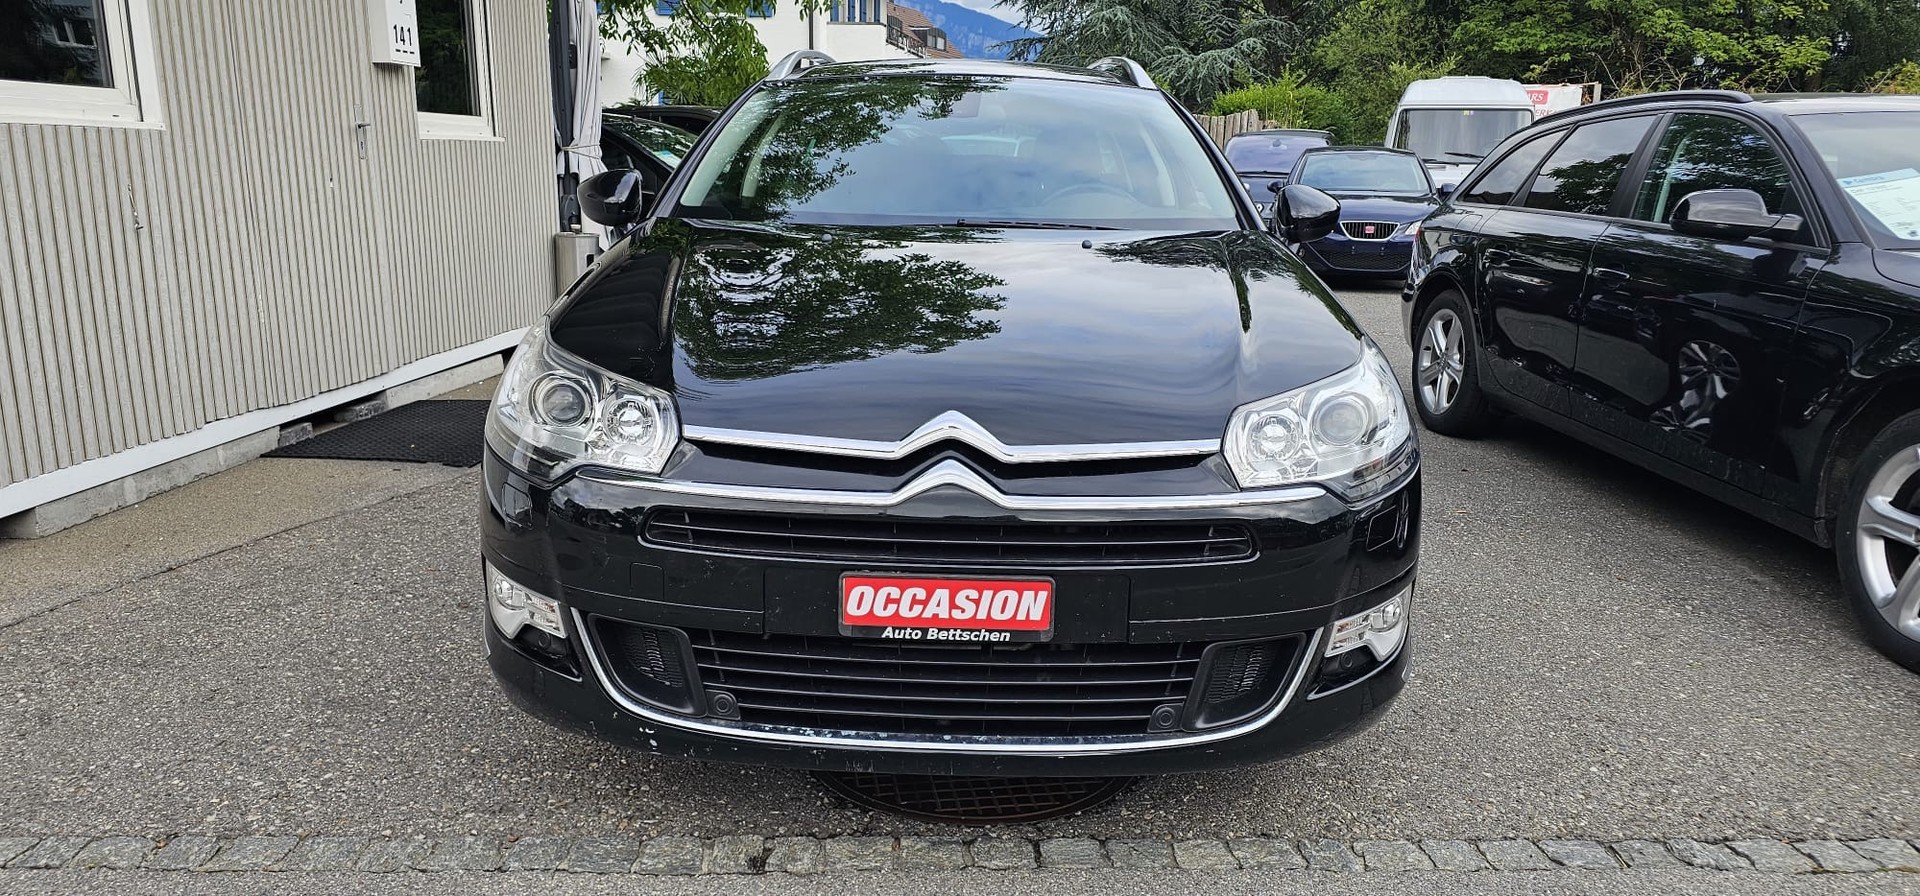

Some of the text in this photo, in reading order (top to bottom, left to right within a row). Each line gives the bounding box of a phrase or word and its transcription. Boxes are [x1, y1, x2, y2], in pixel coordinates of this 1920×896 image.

[393, 24, 412, 46] 141
[846, 585, 1048, 621] OCCASION
[881, 626, 1011, 642] Auto Bettschen
